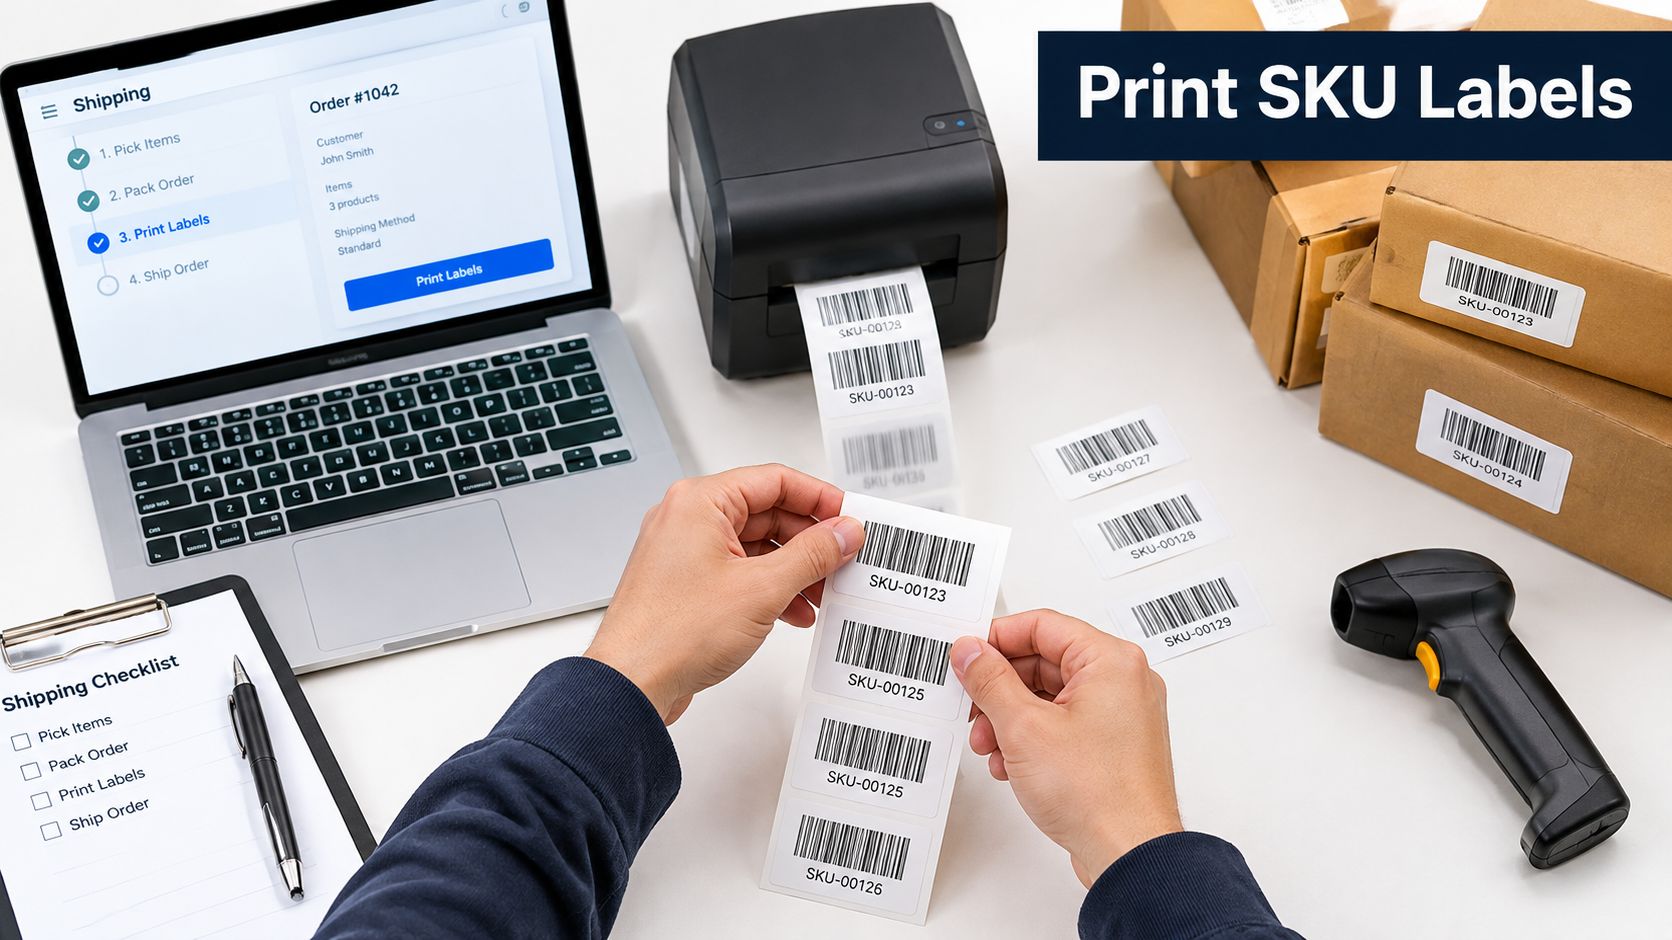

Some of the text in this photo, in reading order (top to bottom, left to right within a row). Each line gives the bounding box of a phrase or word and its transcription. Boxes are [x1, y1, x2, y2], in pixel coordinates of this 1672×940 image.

[73, 87, 151, 112] Shipping
[310, 83, 399, 113] Order #1042
[99, 134, 181, 159] 1. Pick Items
[316, 131, 363, 148] Customer
[320, 147, 374, 166] John Smith
[109, 175, 194, 202] 2. Pack Order
[325, 181, 353, 193] Items
[329, 194, 380, 211] 3 products
[119, 214, 210, 243] 3. Print Labels
[334, 213, 416, 238] Shipping Method
[337, 238, 381, 256] Standard
[129, 259, 209, 284] 4. Ship Order
[416, 264, 483, 287] Print Labels
[1458, 295, 1533, 326] SKU-00123
[849, 384, 914, 404] SKU-00123
[1088, 453, 1150, 482] SKU-00127
[1453, 450, 1522, 488] SKU-00124
[1130, 530, 1196, 559] SKU-00128
[869, 574, 946, 602] SKU-00123
[1164, 617, 1232, 647] SKU-00129
[2, 655, 180, 712] Shipping Checklist
[848, 673, 925, 701] SKU-00125
[38, 716, 113, 743] Pick Items
[48, 742, 128, 772] Pack Order
[58, 769, 146, 801] Print Labels
[827, 770, 904, 798] SKU-00125
[69, 799, 149, 831] Ship Order
[806, 867, 883, 895] SKU-00126
